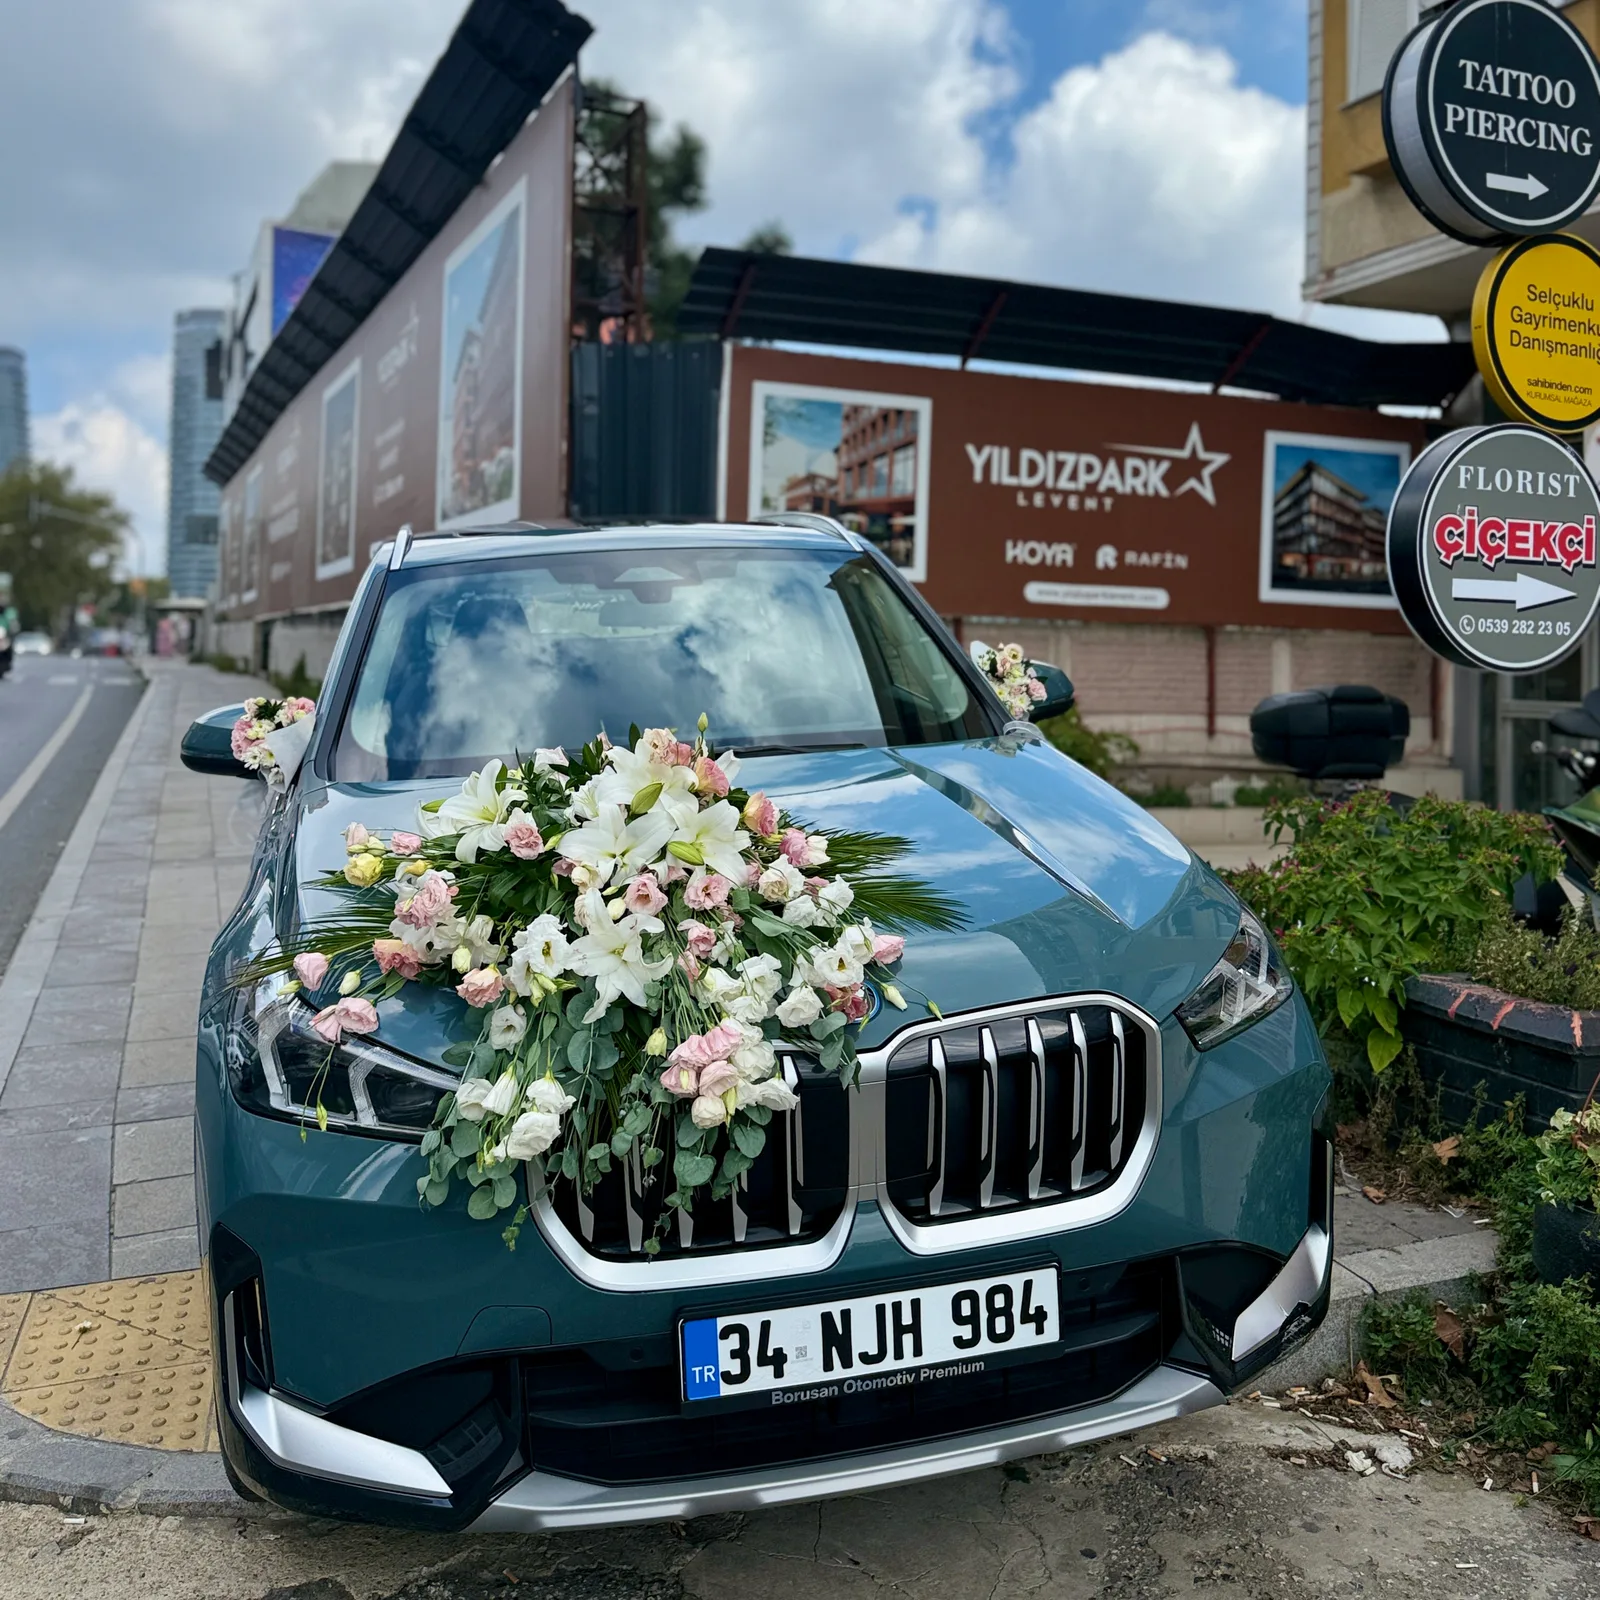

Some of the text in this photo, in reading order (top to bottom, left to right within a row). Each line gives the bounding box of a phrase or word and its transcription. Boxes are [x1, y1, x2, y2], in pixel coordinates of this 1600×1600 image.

[1458, 59, 1576, 109] TATTOO
[1444, 103, 1593, 156] PIERCING
[1527, 284, 1594, 312] Selçuklu
[1526, 391, 1562, 404] KURUMSAL
[1527, 377, 1592, 396] sahibinden.com
[965, 443, 1171, 497] YILDIZPARK
[1457, 465, 1580, 498] FLORIST
[1017, 491, 1114, 512] LEVENT
[1433, 505, 1597, 575] ÇİÇEKÇİ
[1478, 618, 1571, 636] 0539 282 23 05
[718, 1278, 1048, 1386] 34 NJH 984
[691, 1365, 716, 1384] TR
[771, 1359, 985, 1405] Borusan Otomotiv Premium
